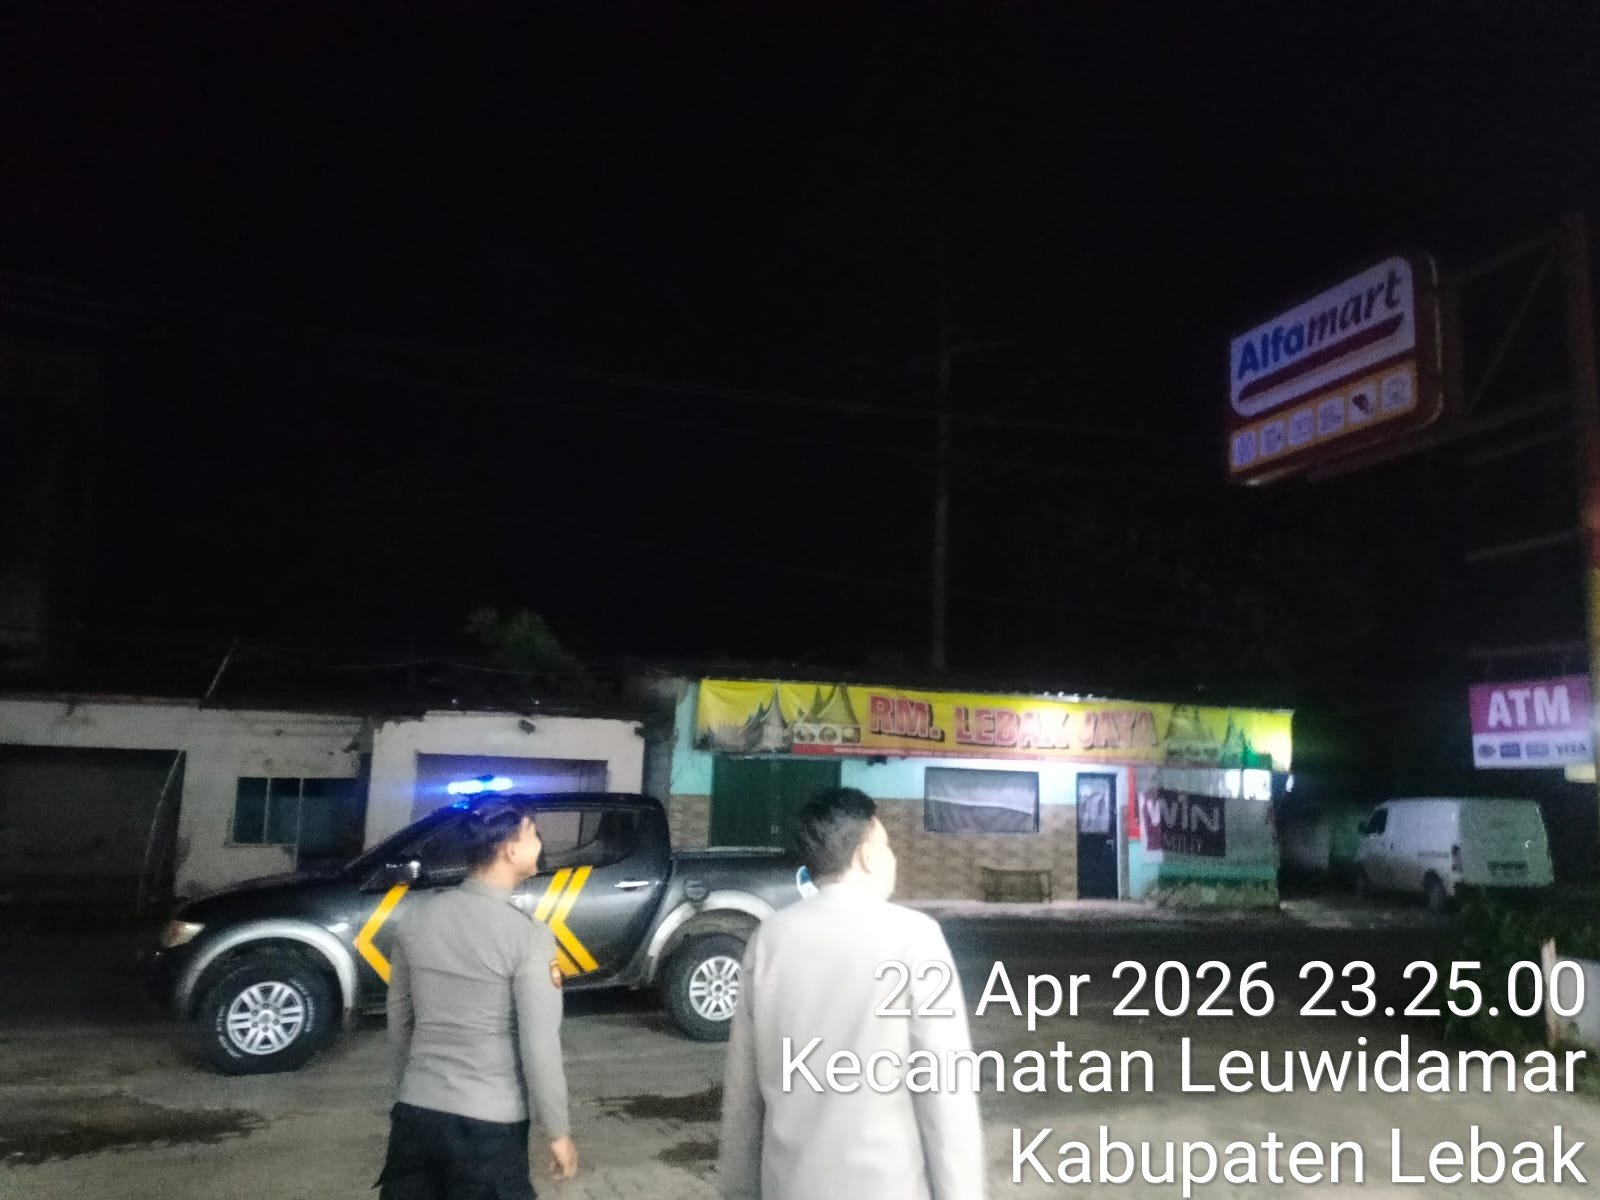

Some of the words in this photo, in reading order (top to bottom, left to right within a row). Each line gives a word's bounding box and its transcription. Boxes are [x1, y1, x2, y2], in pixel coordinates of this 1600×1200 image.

[1238, 269, 1402, 381] Alfamart
[868, 695, 943, 741] RM.
[955, 705, 1070, 748] LEBAK
[1077, 709, 1159, 750] JAYA
[1487, 685, 1572, 728] ATM
